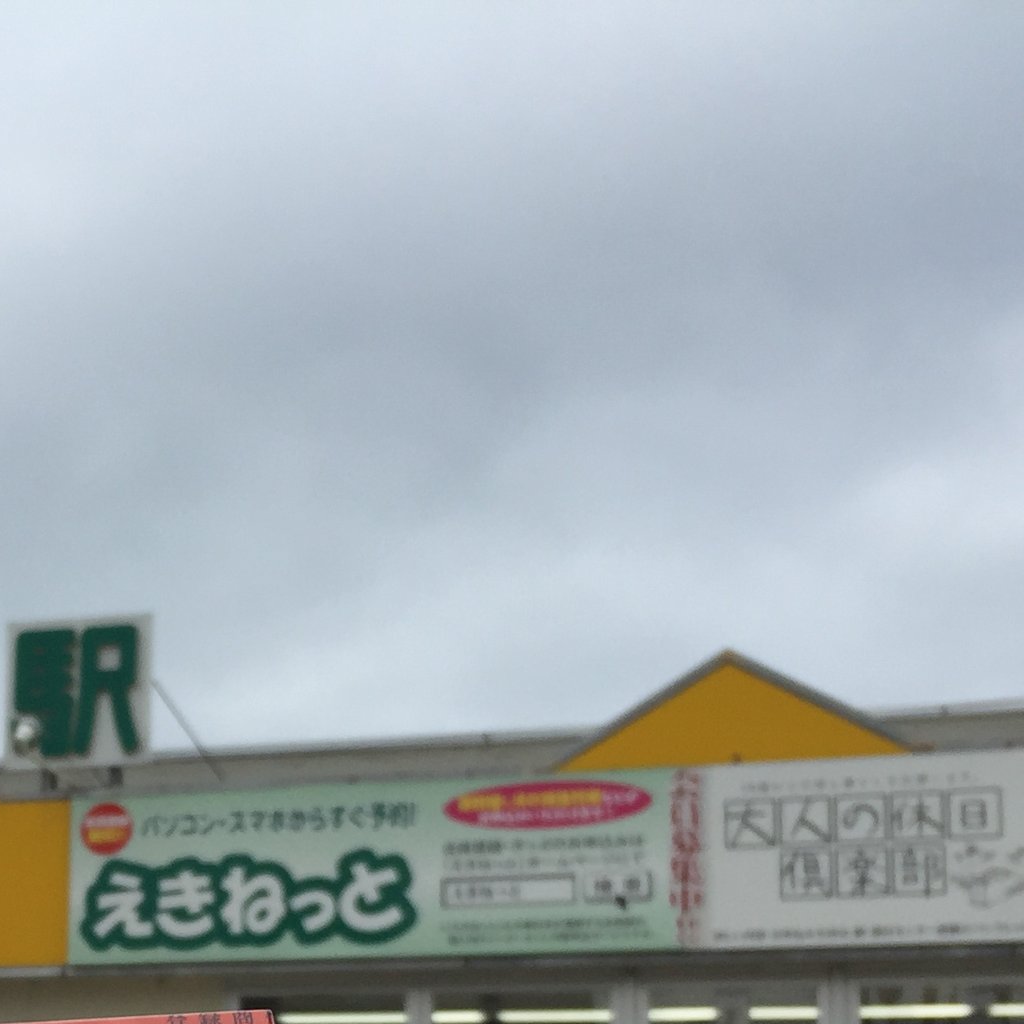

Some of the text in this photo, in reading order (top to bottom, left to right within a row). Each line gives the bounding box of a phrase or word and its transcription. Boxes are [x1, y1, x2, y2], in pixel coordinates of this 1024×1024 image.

[12, 624, 141, 757] 駅
[87, 853, 408, 946] えきねっと
